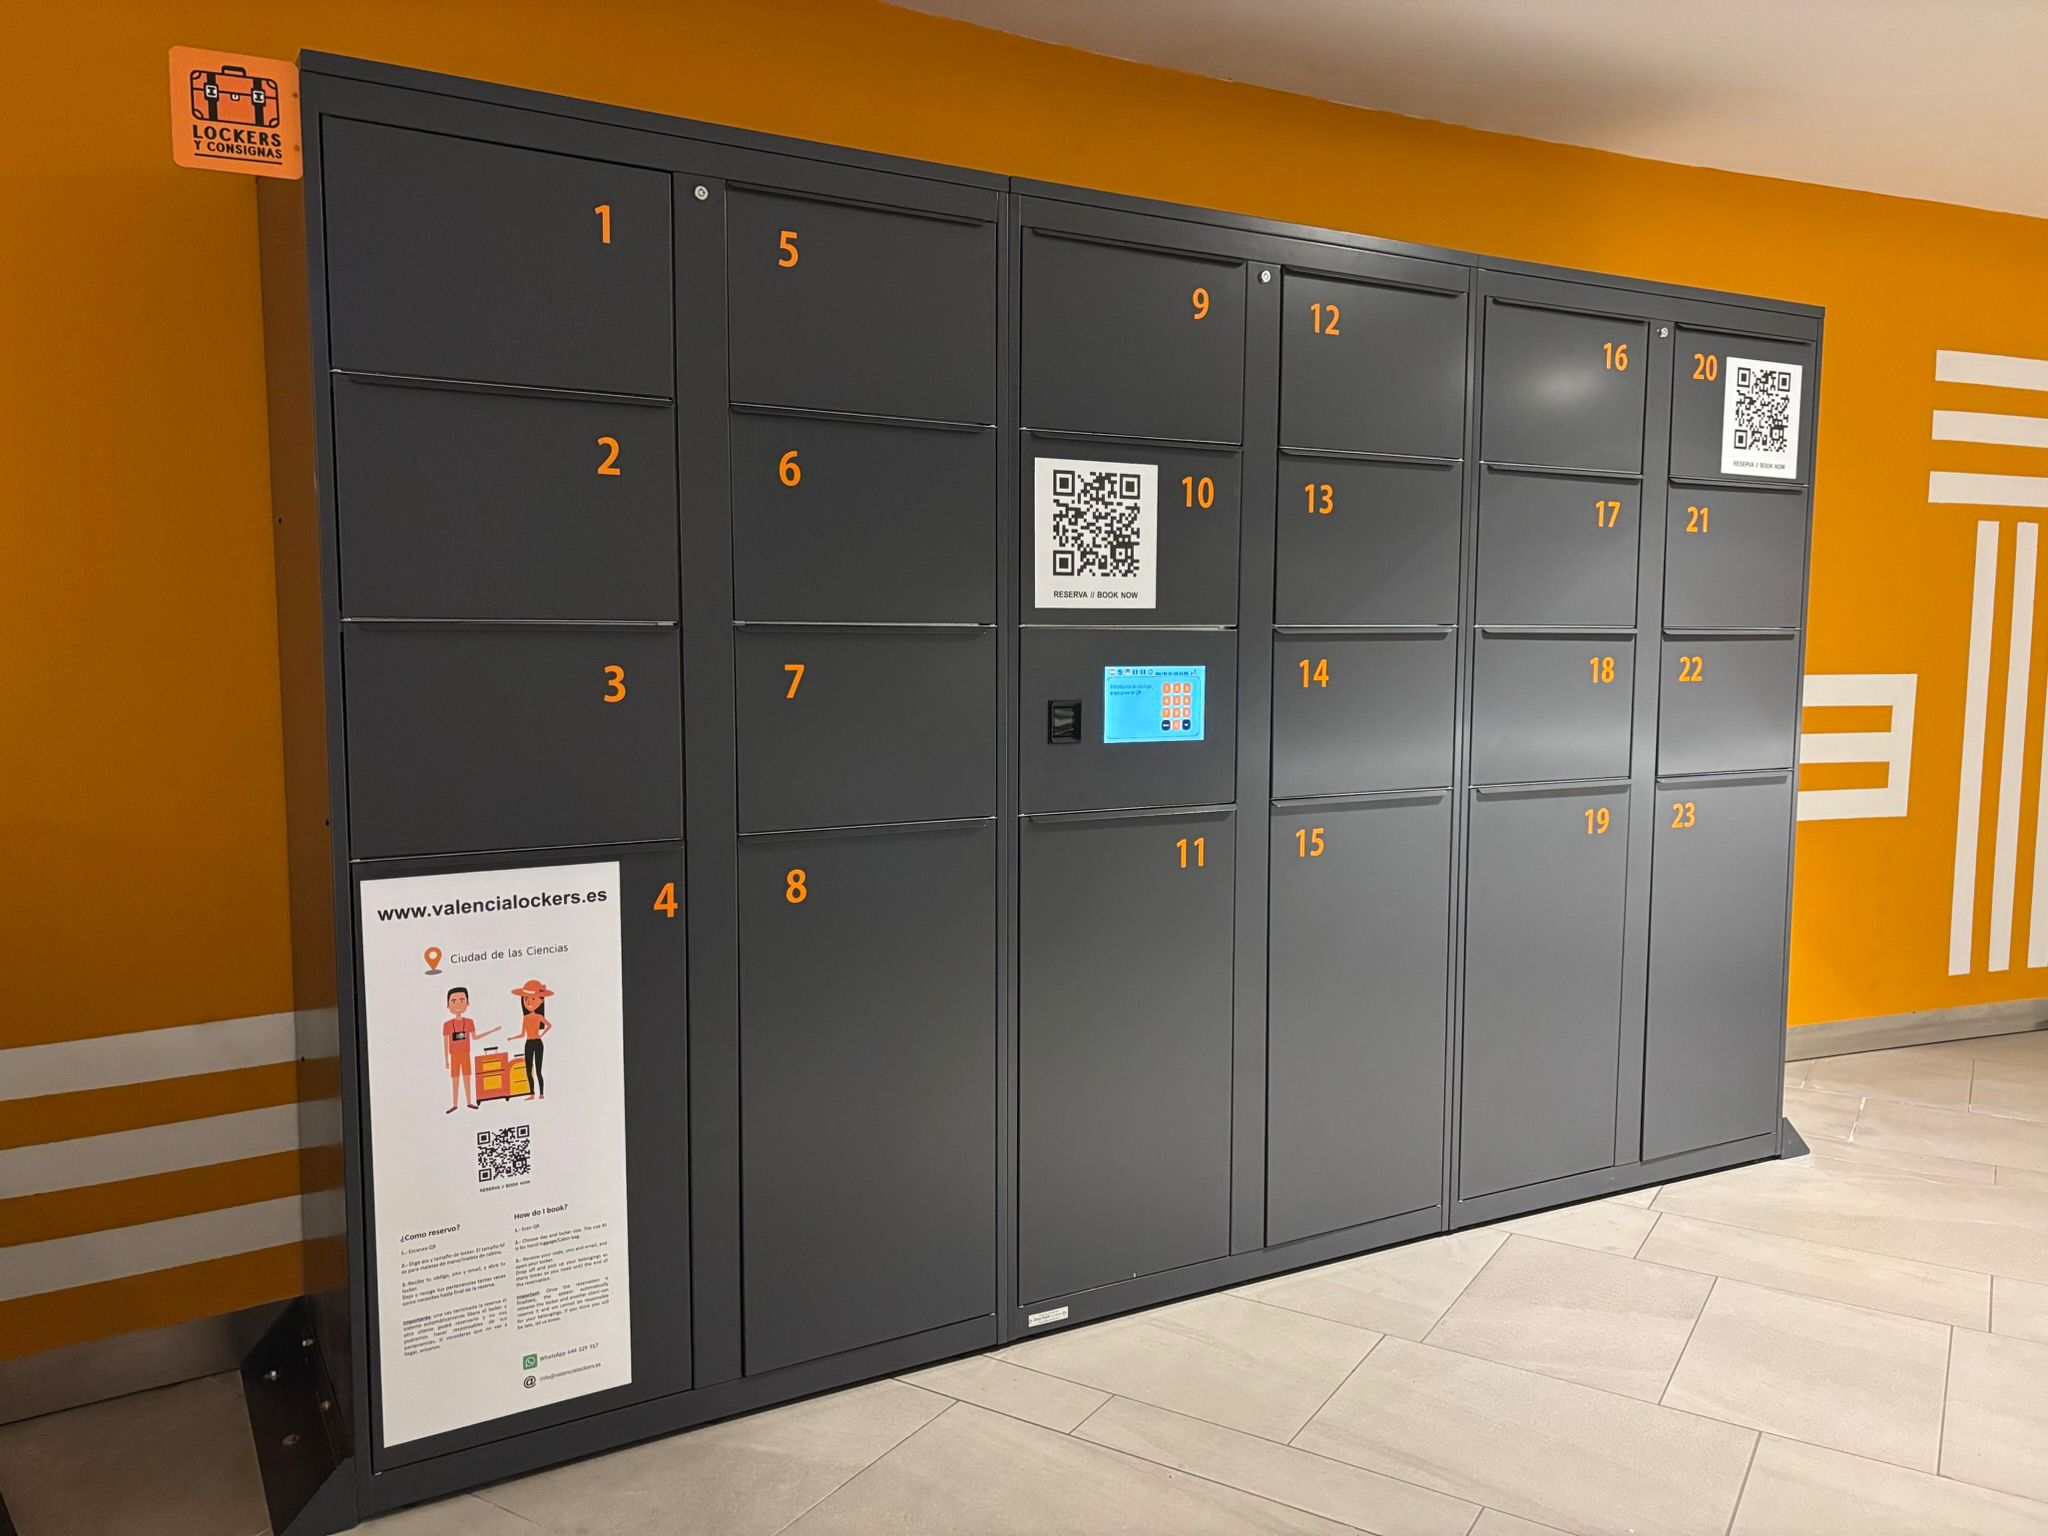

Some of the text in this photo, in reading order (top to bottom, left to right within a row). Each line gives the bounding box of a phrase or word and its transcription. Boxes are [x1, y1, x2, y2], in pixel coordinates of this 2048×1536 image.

[192, 124, 282, 147] LOCKERS
[194, 140, 282, 159] Y CONSIGNAS
[595, 205, 610, 243] 1
[778, 231, 799, 268] 5
[1192, 288, 1209, 320] 9
[1310, 304, 1340, 336] 12
[1603, 343, 1628, 372] 16
[1693, 353, 1718, 381] 20
[597, 437, 620, 475] 2
[778, 451, 801, 486] 6
[1182, 477, 1214, 508] 10
[1304, 484, 1333, 514] 13
[1595, 501, 1621, 528] 17
[1686, 507, 1709, 533] 21
[1053, 590, 1088, 599] RESERVA
[1090, 591, 1095, 599] //
[1097, 591, 1119, 599] BOOK
[603, 665, 626, 703] 3
[784, 664, 804, 698] 7
[1299, 659, 1329, 688] 14
[1590, 657, 1615, 684] 18
[1678, 656, 1703, 683] 22
[1585, 809, 1610, 834] 19
[1672, 803, 1695, 829] 23
[1176, 838, 1204, 868] 11
[1295, 828, 1325, 858] 15
[653, 883, 678, 918] 4
[785, 869, 807, 904] 8
[377, 890, 607, 921] www.valencialockers.es
[450, 942, 569, 964] Ciudad de las Ciencias
[514, 1211, 531, 1220] How
[532, 1209, 542, 1217] do
[547, 1204, 568, 1214] book?
[400, 1224, 460, 1243] ¿Como reservo?
[540, 1351, 566, 1361] WhatsApp
